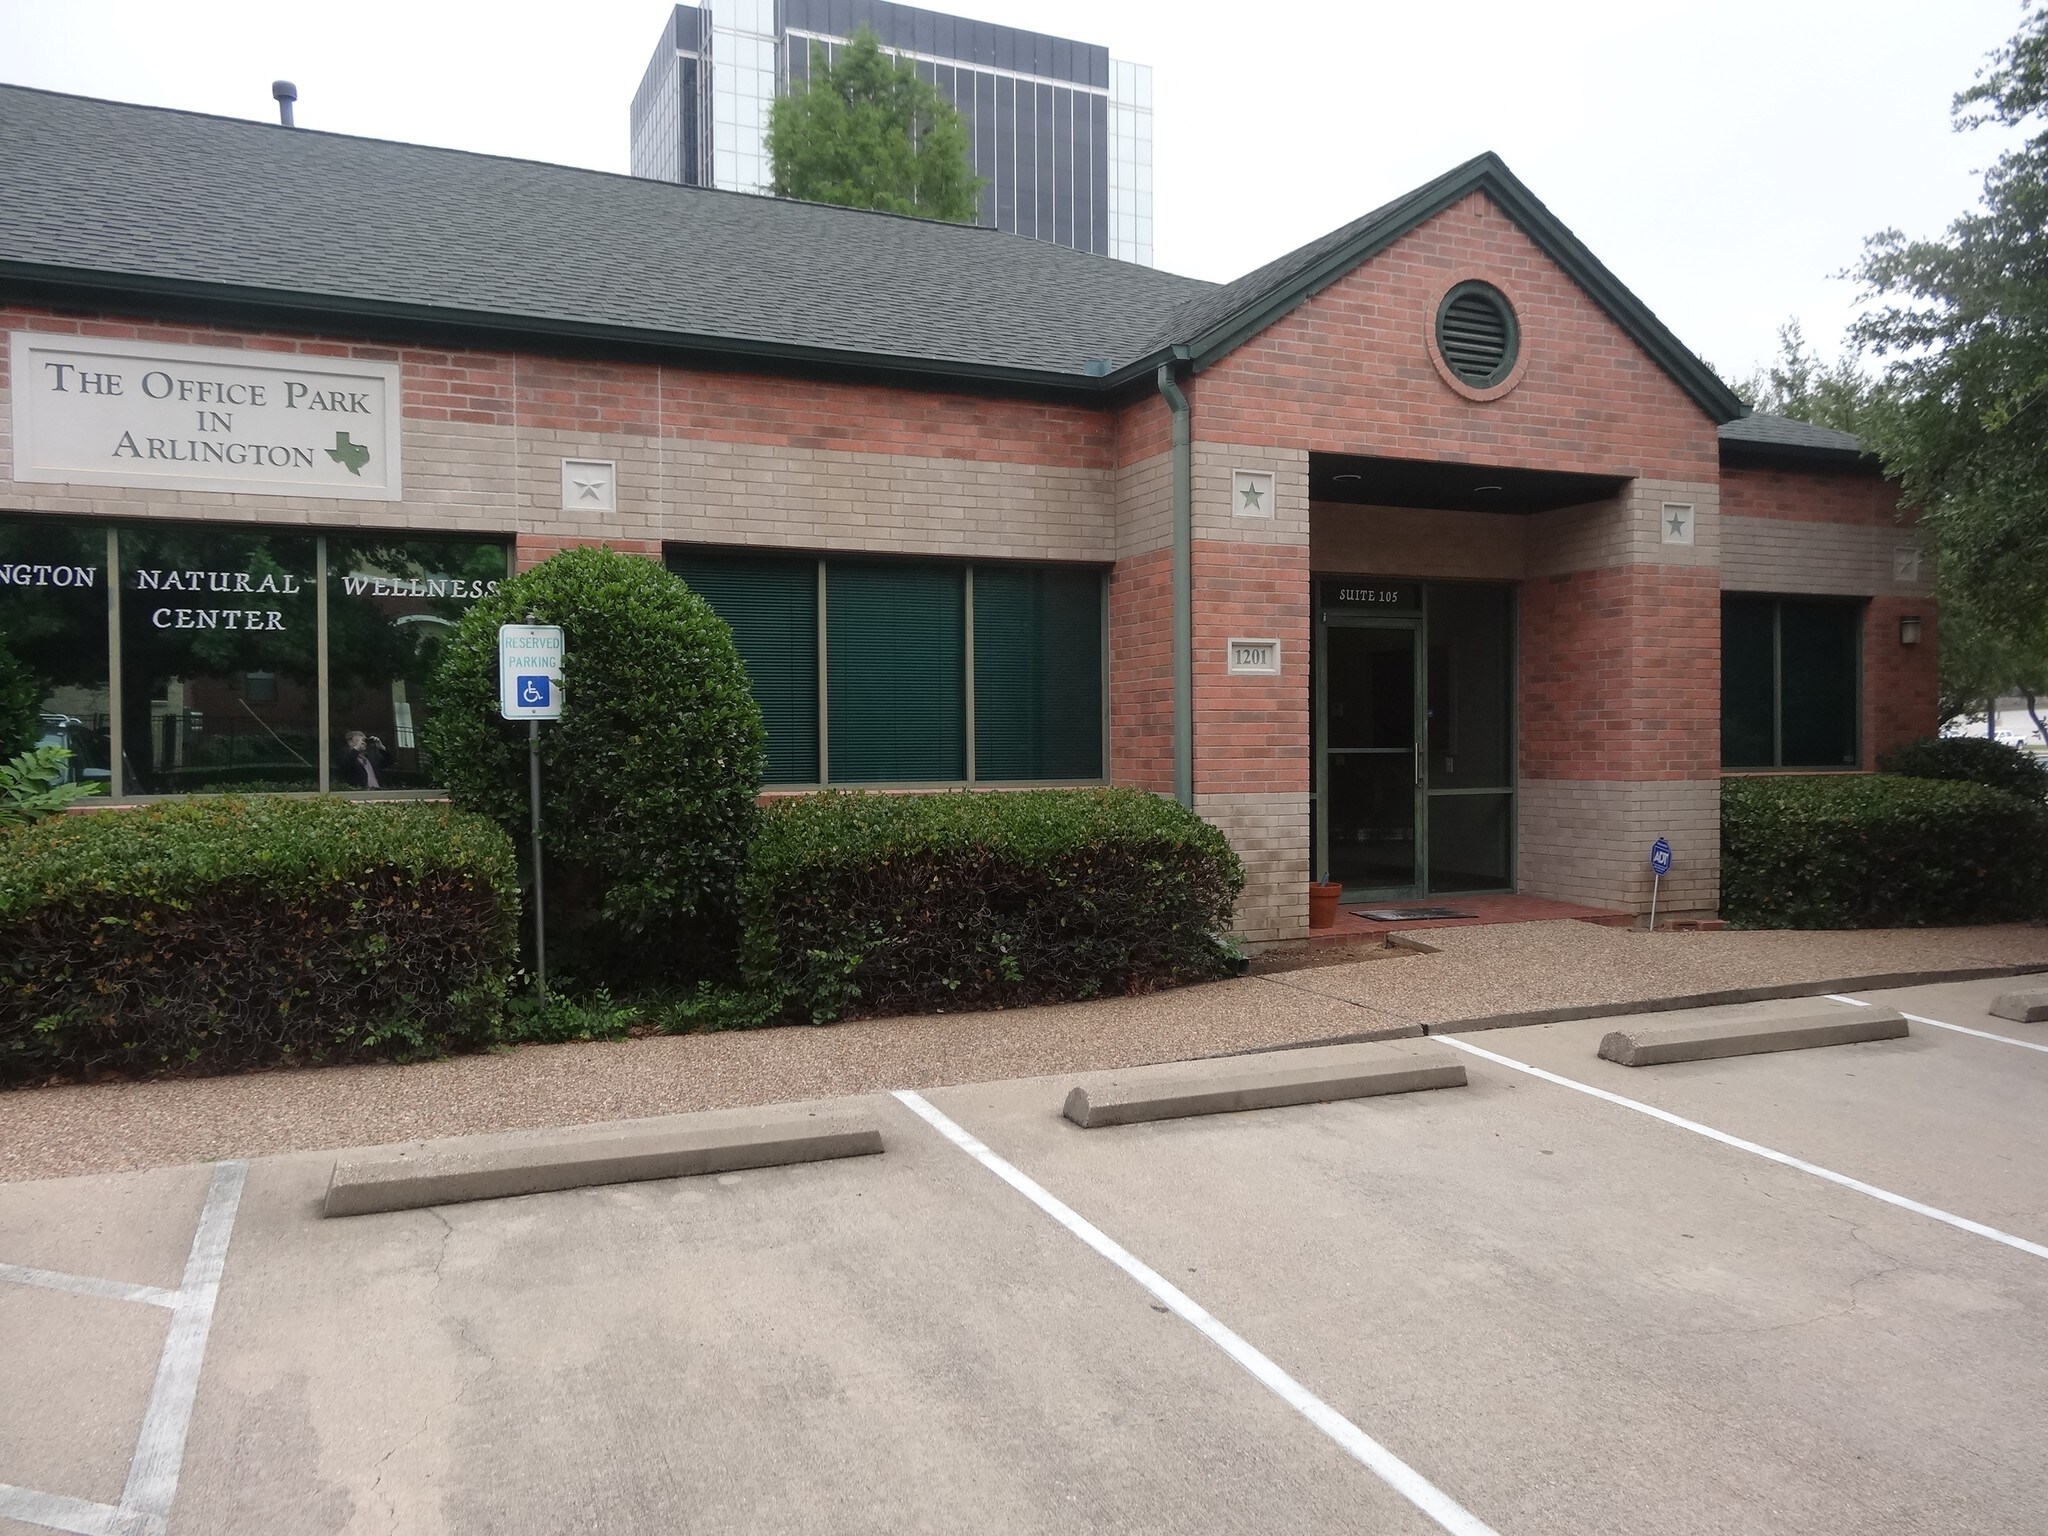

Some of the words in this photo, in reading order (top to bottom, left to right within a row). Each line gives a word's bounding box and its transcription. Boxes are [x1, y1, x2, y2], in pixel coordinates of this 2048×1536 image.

[45, 362, 124, 396] THE
[141, 371, 267, 407] OFFICE
[283, 381, 372, 415] PARK
[196, 410, 233, 433] IN
[111, 430, 315, 468] ARLINGTON
[0, 564, 97, 588] NGTON
[136, 569, 300, 594] NATURAL
[341, 576, 500, 599] WELLNESS
[1339, 588, 1375, 601] SUITE
[1378, 590, 1399, 603] 105
[152, 607, 286, 631] CENTER
[505, 637, 560, 649] RESERVED
[508, 656, 556, 668] PARKING
[1235, 648, 1267, 665] 1201
